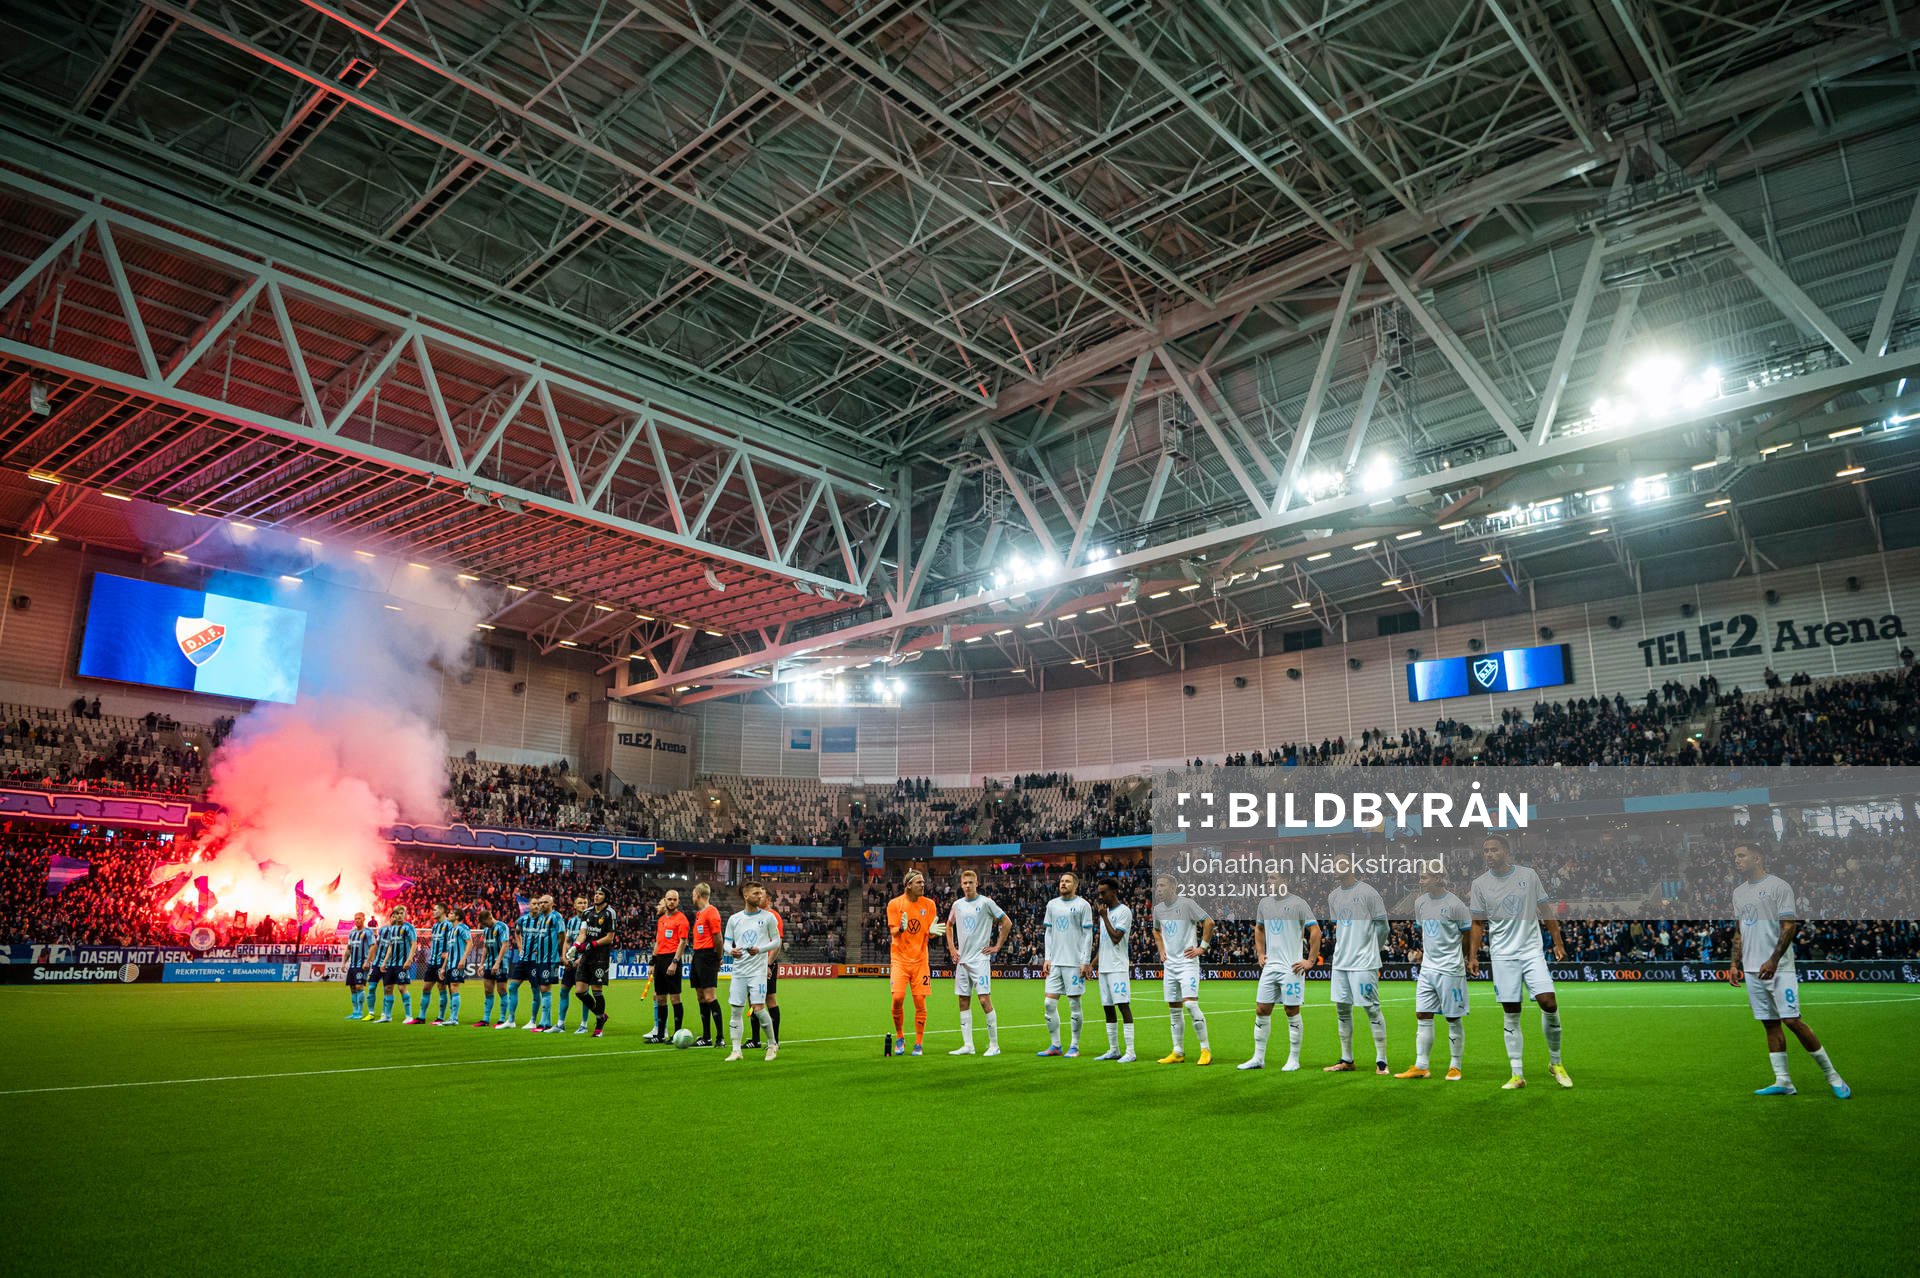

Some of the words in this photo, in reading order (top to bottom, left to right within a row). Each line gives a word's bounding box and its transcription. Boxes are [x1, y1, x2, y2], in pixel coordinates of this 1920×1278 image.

[1637, 613, 1763, 667] TELE2
[1772, 614, 1908, 653] Arena
[618, 733, 652, 749] TELE2
[654, 738, 687, 754] Arena
[33, 966, 118, 981] Sundström
[779, 966, 832, 976] BAUHAUS
[1208, 970, 1260, 979] FXORO.COM
[1601, 969, 1676, 980] FXORO.COM
[1807, 969, 1896, 981] FXORO.COM
[978, 975, 989, 985] 31
[1113, 982, 1127, 993] 22
[1286, 982, 1301, 995] 25
[1785, 988, 1795, 1003] 8
